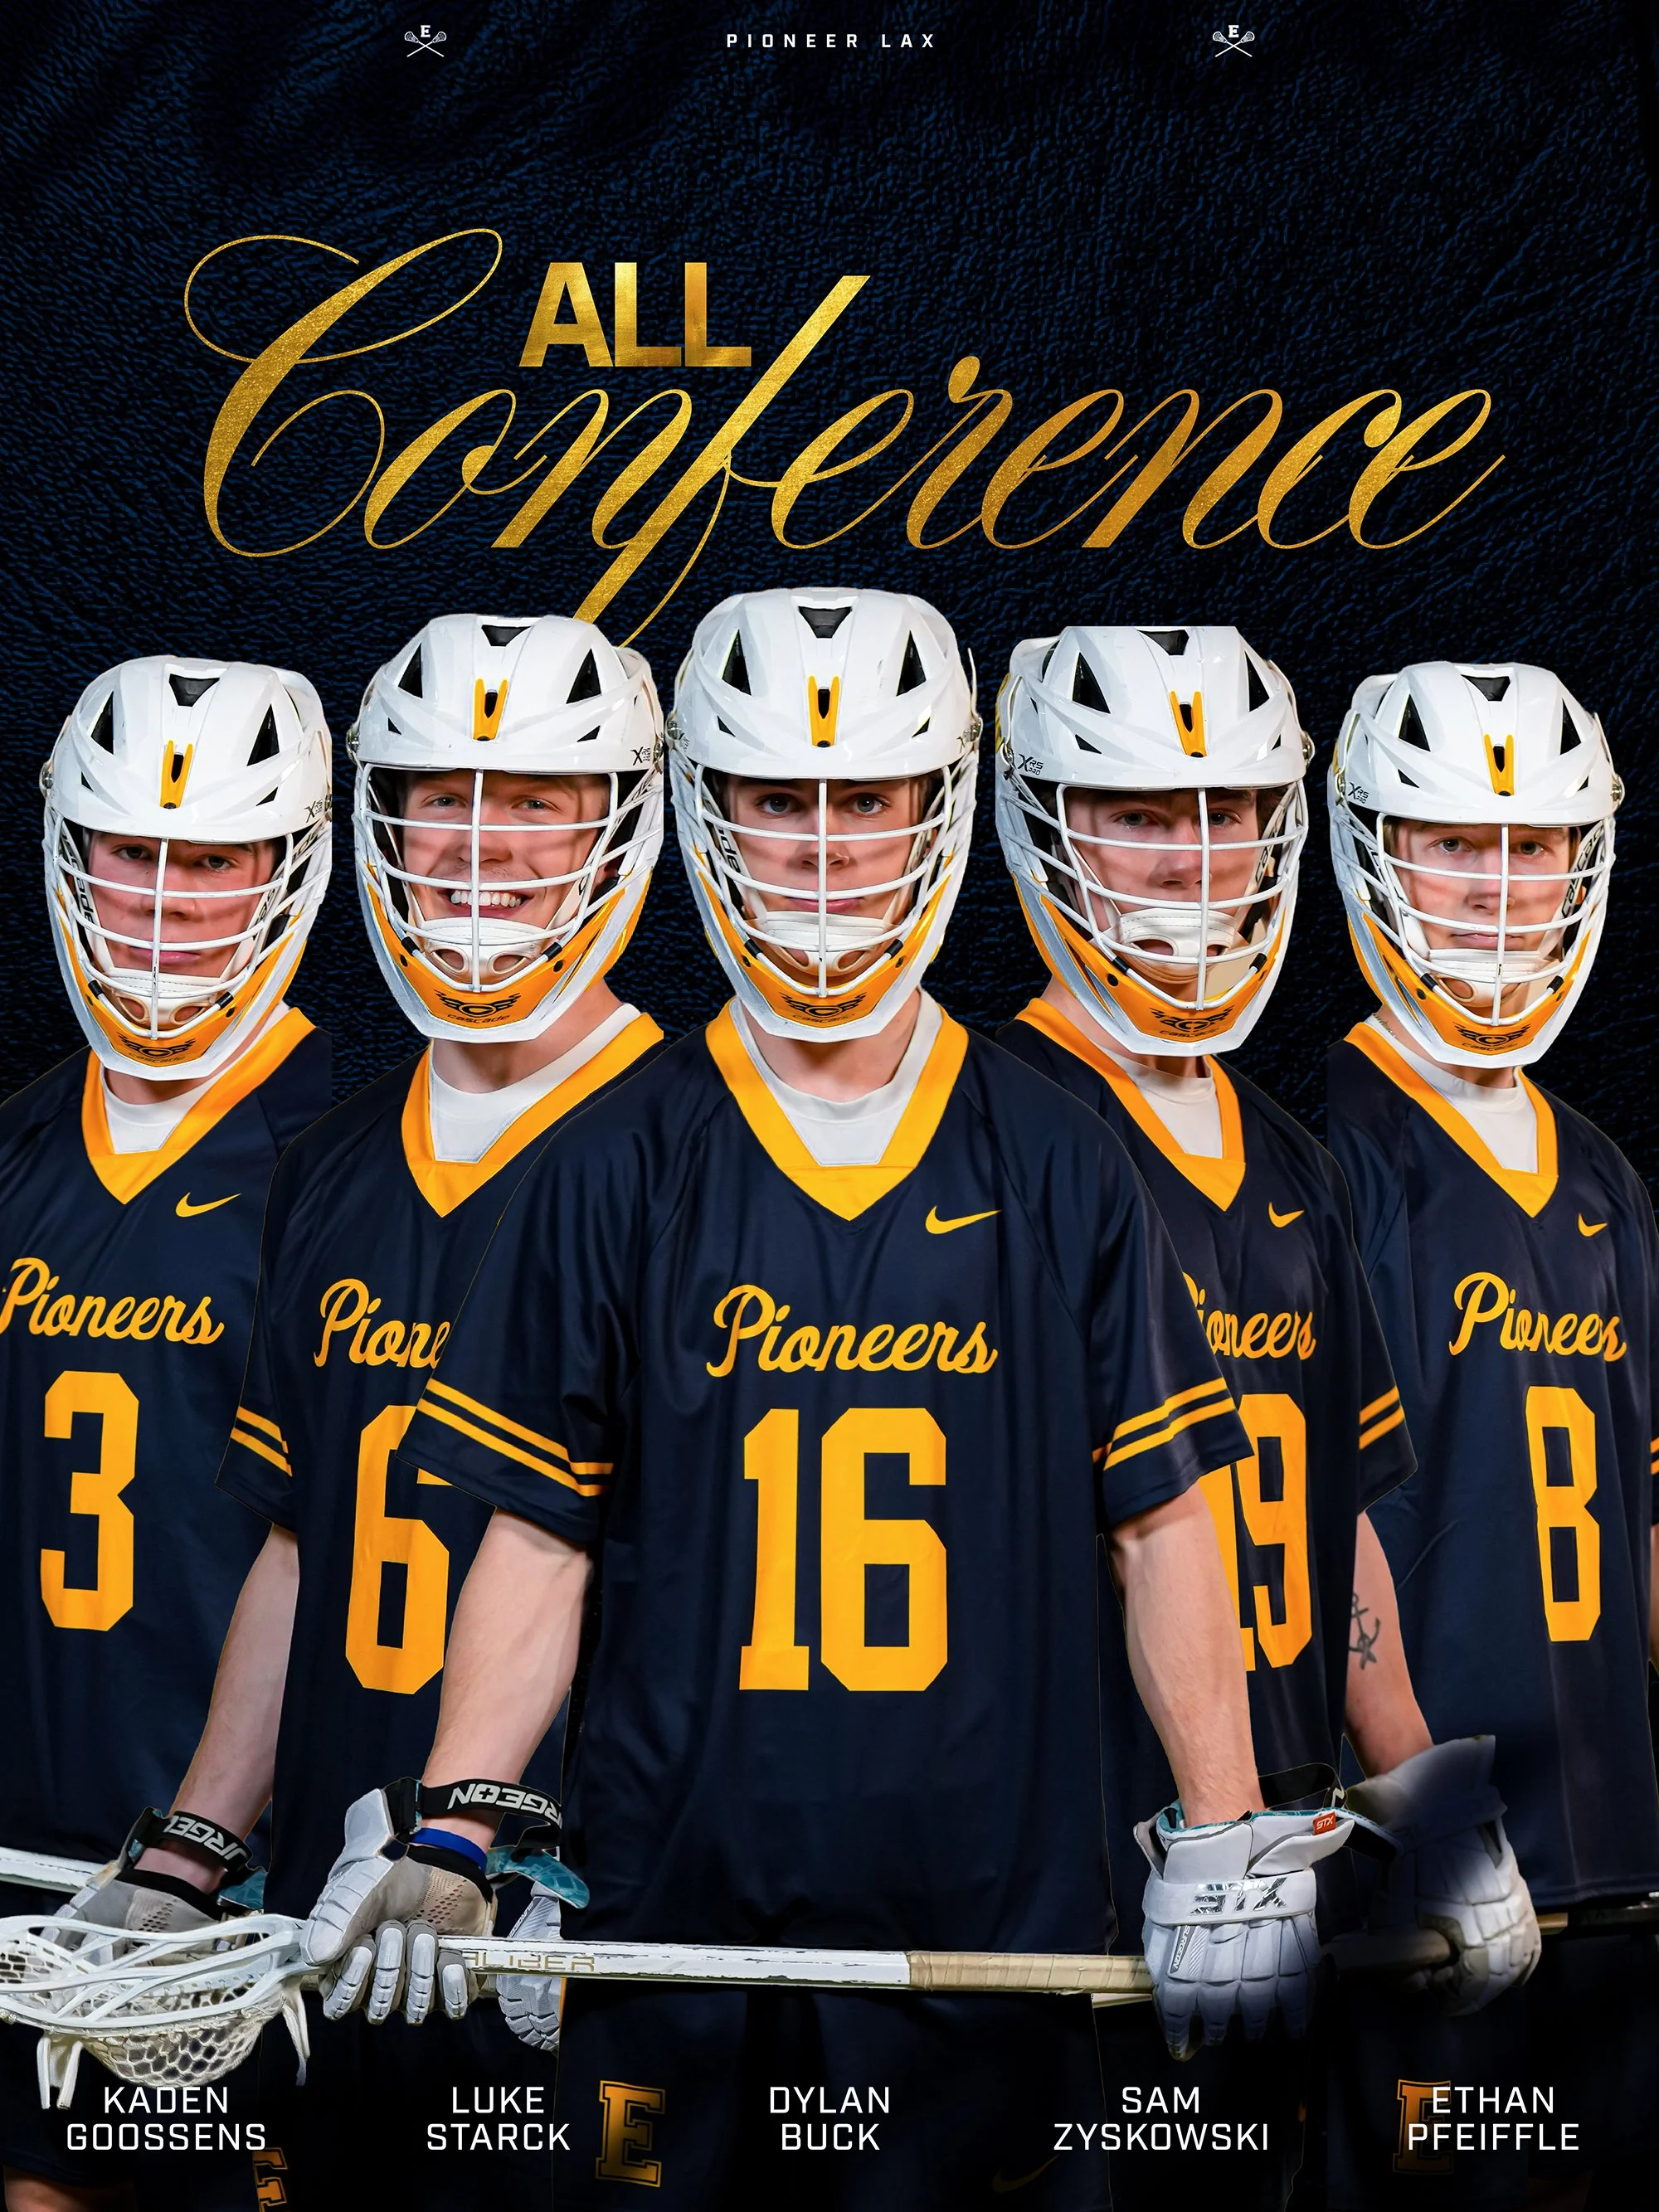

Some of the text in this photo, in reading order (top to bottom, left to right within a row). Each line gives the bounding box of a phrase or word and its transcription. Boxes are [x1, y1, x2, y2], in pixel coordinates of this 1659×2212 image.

[447, 1013, 511, 1024] cascade
[0, 1257, 225, 1344] Pioneers
[706, 1284, 998, 1378] Pioneers
[41, 1370, 139, 1631] 3
[345, 1404, 452, 1694] 6
[738, 1407, 948, 1692] 16
[1525, 1386, 1602, 1642] 8
[447, 1783, 562, 1830] RGEON
[1316, 1815, 1334, 1830] STX
[595, 2079, 665, 2188] E
